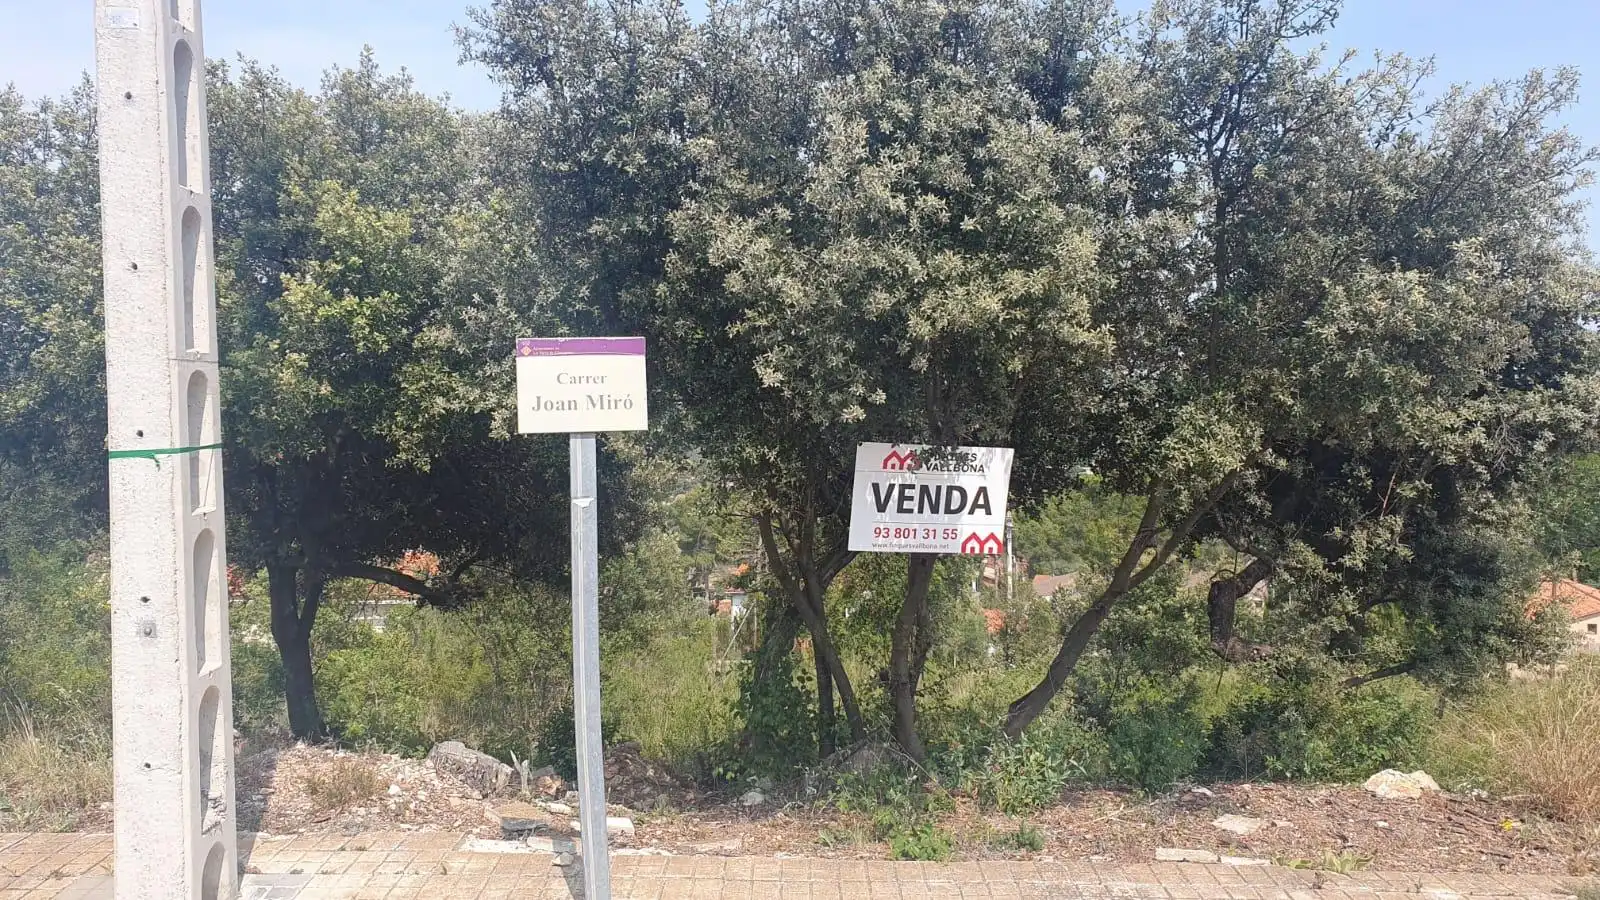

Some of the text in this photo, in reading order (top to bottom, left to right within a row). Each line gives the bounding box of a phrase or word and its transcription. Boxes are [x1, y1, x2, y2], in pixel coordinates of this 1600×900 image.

[556, 372, 608, 385] Carrer
[531, 393, 634, 412] Joan Miró
[925, 463, 985, 473] VALLBONA
[871, 482, 993, 516] VENDA
[873, 526, 958, 540] 93 801 31 55
